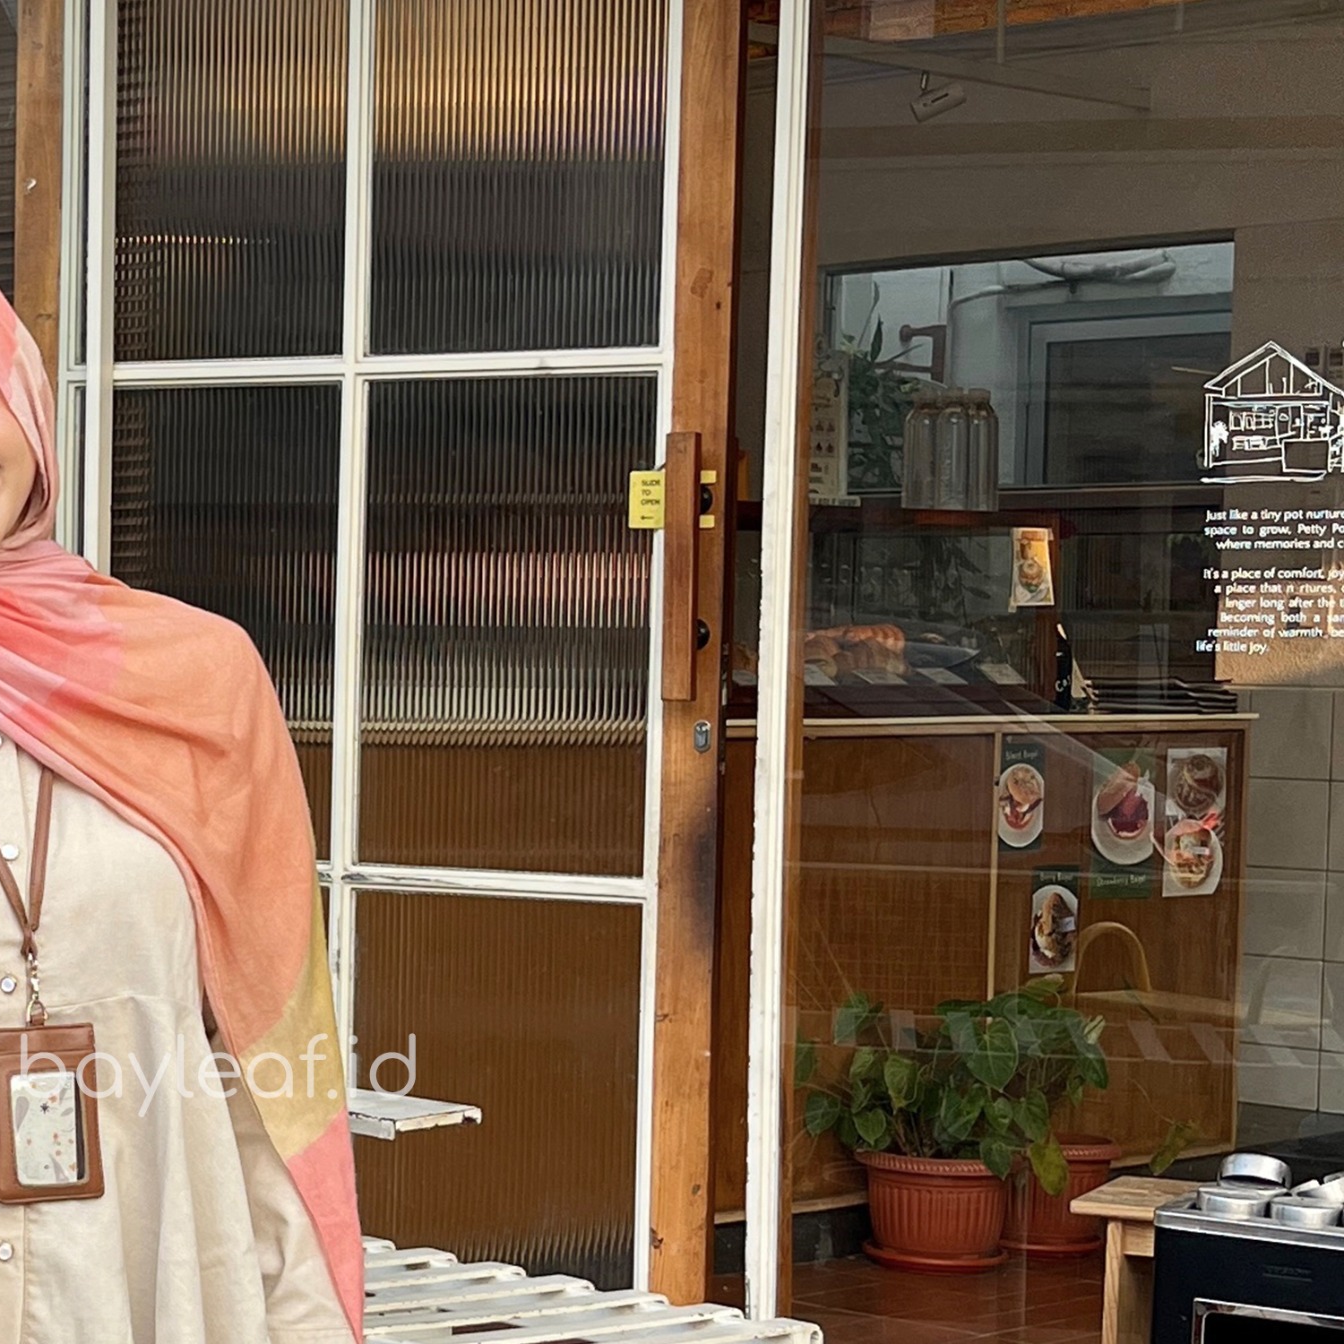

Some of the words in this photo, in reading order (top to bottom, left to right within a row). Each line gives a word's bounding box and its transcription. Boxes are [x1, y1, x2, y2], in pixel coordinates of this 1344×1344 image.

[641, 489, 652, 497] TO
[640, 498, 661, 506] OPEN
[1206, 510, 1227, 522] Just
[1229, 509, 1248, 520] like
[1251, 511, 1258, 520] a
[1260, 508, 1281, 522] tiny
[1284, 509, 1303, 522] pot
[1204, 526, 1237, 538] space
[1242, 525, 1254, 535] to
[1297, 522, 1327, 537] Petty
[1216, 538, 1252, 550] where
[1254, 538, 1311, 549] memories
[1313, 537, 1335, 549] and
[1221, 570, 1229, 579] a
[1231, 567, 1261, 581] place
[1263, 566, 1276, 579] of
[1214, 584, 1221, 594] a
[1226, 582, 1256, 595] place
[1260, 582, 1282, 593] that
[1225, 596, 1256, 611] linger
[1260, 596, 1284, 611] long
[1288, 596, 1314, 608] after
[1317, 596, 1336, 608] the
[1220, 611, 1275, 625] Becoming
[1281, 611, 1306, 622] both
[1313, 614, 1321, 623] a
[1208, 625, 1259, 637] reminder
[1263, 626, 1275, 638] of
[1196, 639, 1221, 652] life's
[1223, 640, 1248, 652] little
